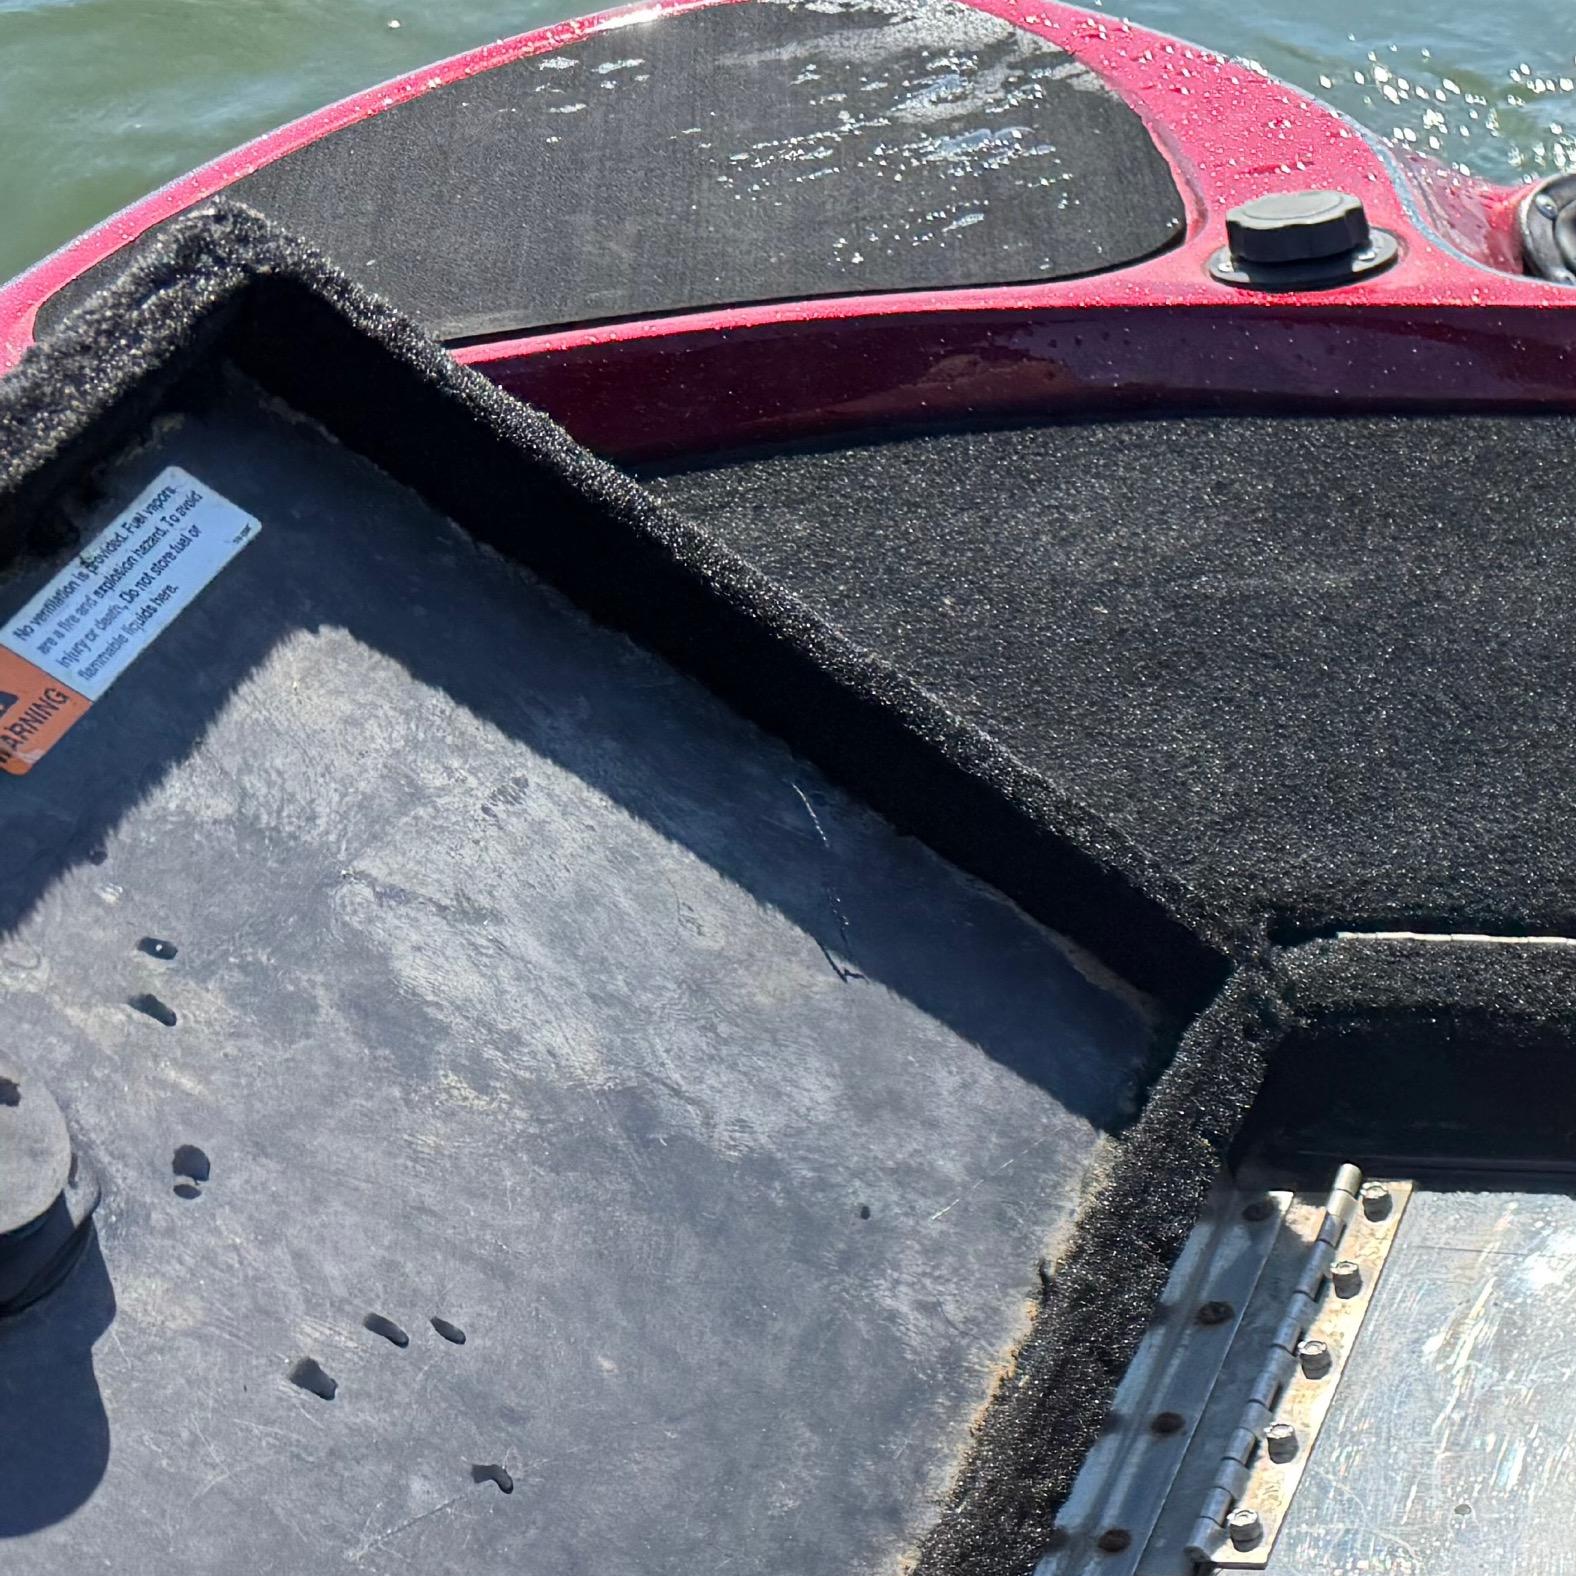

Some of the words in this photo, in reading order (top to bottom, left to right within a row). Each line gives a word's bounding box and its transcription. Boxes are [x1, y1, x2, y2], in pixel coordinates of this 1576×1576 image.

[175, 490, 203, 517] avoid
[159, 513, 181, 528] To
[130, 526, 169, 559] hazard.
[12, 625, 35, 641] No
[30, 580, 81, 626] ventilation
[71, 566, 90, 582] is
[120, 512, 148, 535] Fuel
[84, 628, 99, 642] or
[118, 588, 140, 605] Do
[134, 571, 156, 592] not
[150, 551, 177, 576] store
[169, 533, 193, 554] fuel
[188, 524, 202, 538] or
[75, 594, 98, 616] and
[53, 629, 65, 639] a
[57, 614, 80, 632] fire
[77, 633, 129, 681] flammable
[120, 604, 158, 636] liquids
[149, 584, 179, 607] here.
[37, 637, 58, 655] are
